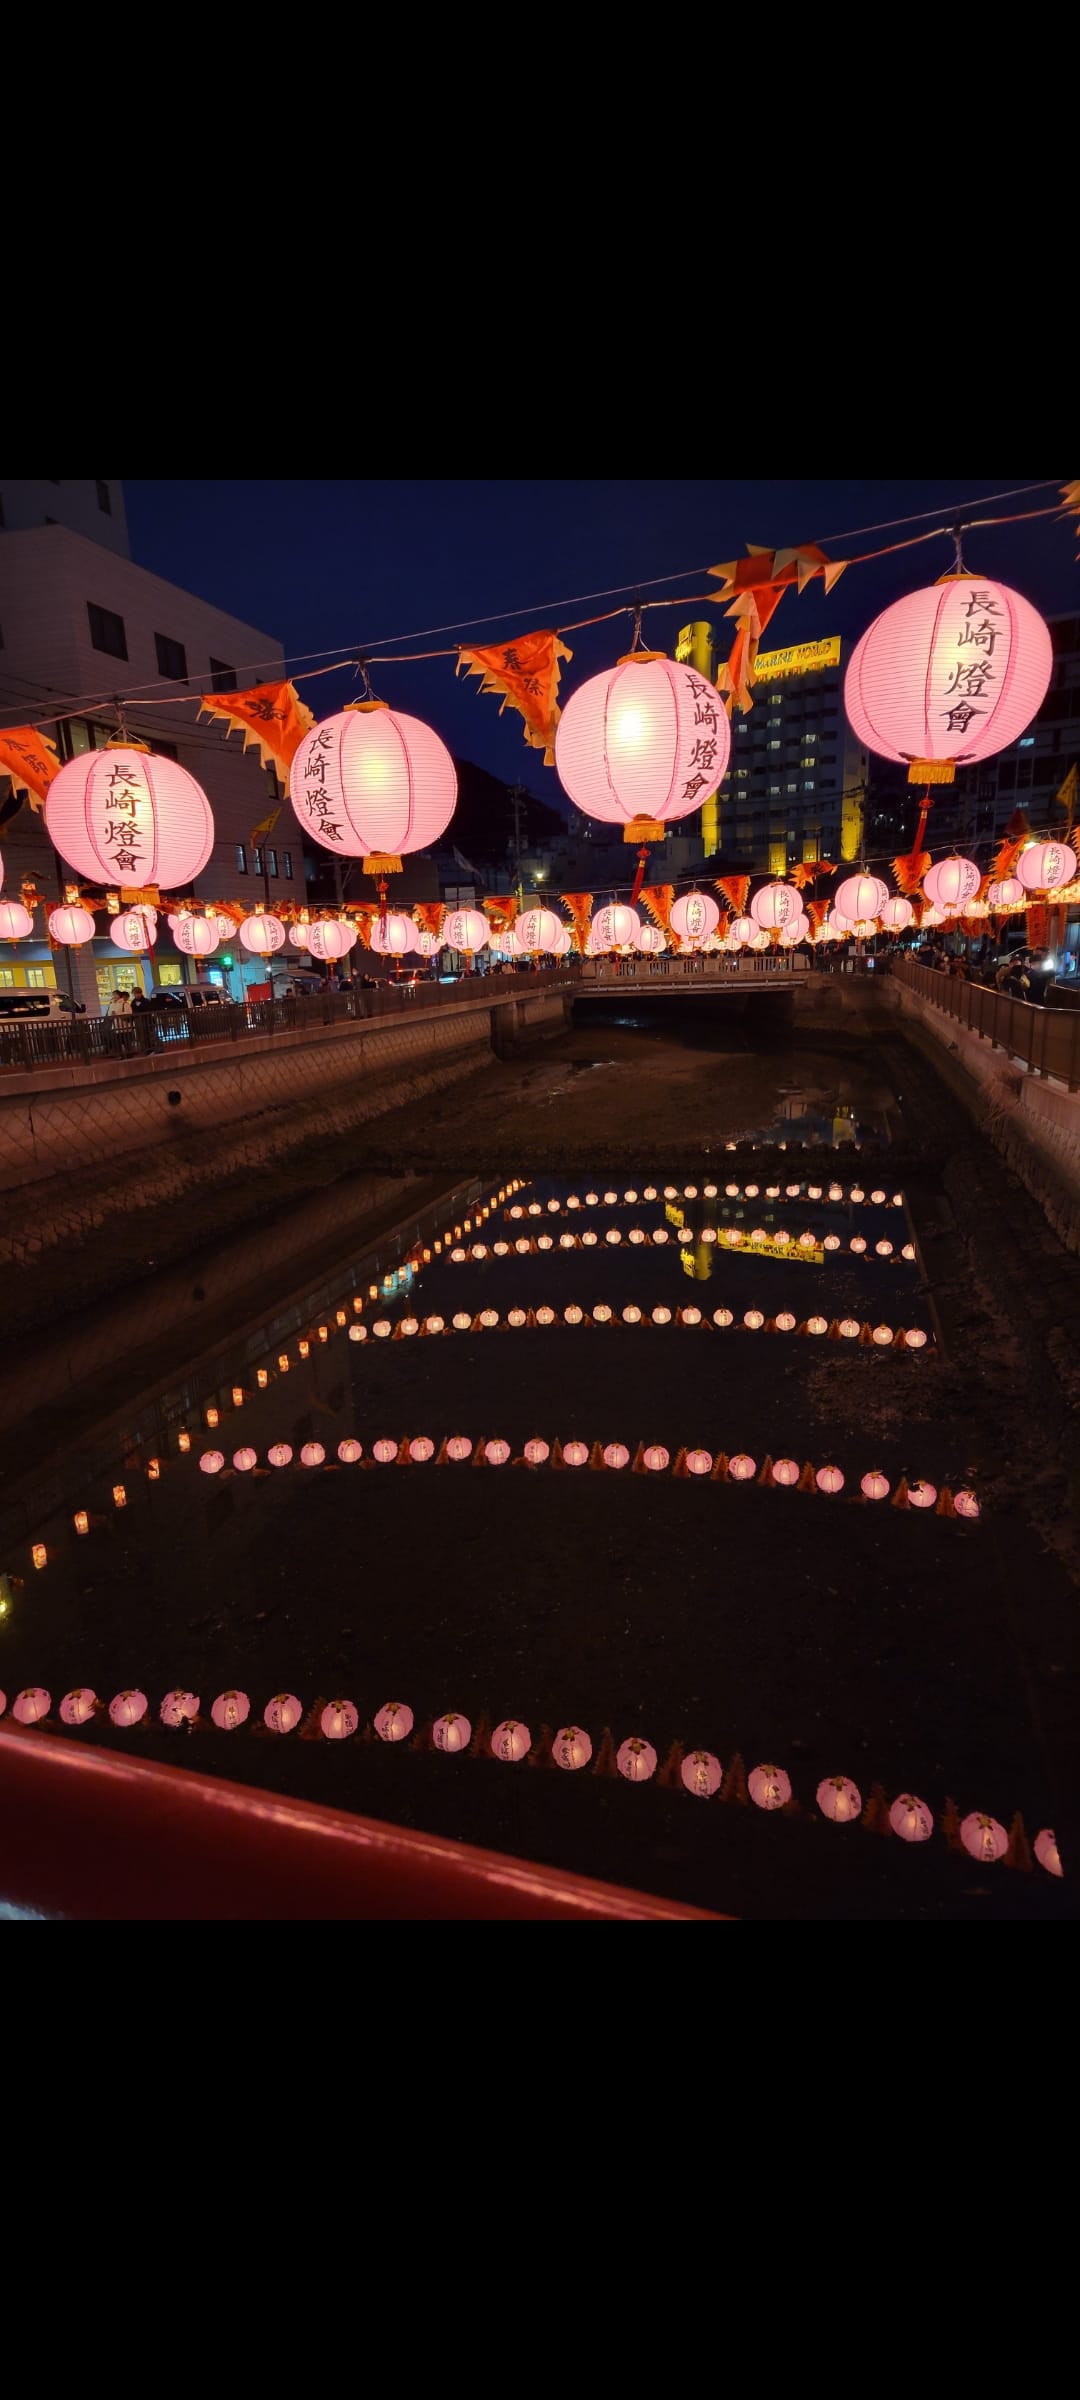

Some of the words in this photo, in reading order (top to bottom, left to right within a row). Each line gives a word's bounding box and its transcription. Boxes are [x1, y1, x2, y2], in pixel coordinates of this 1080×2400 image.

[939, 590, 1005, 734] 長崎燈會
[304, 728, 344, 841] 長崎燈會
[681, 673, 720, 800] 長崎燈會
[105, 764, 147, 872] 長崎燈會
